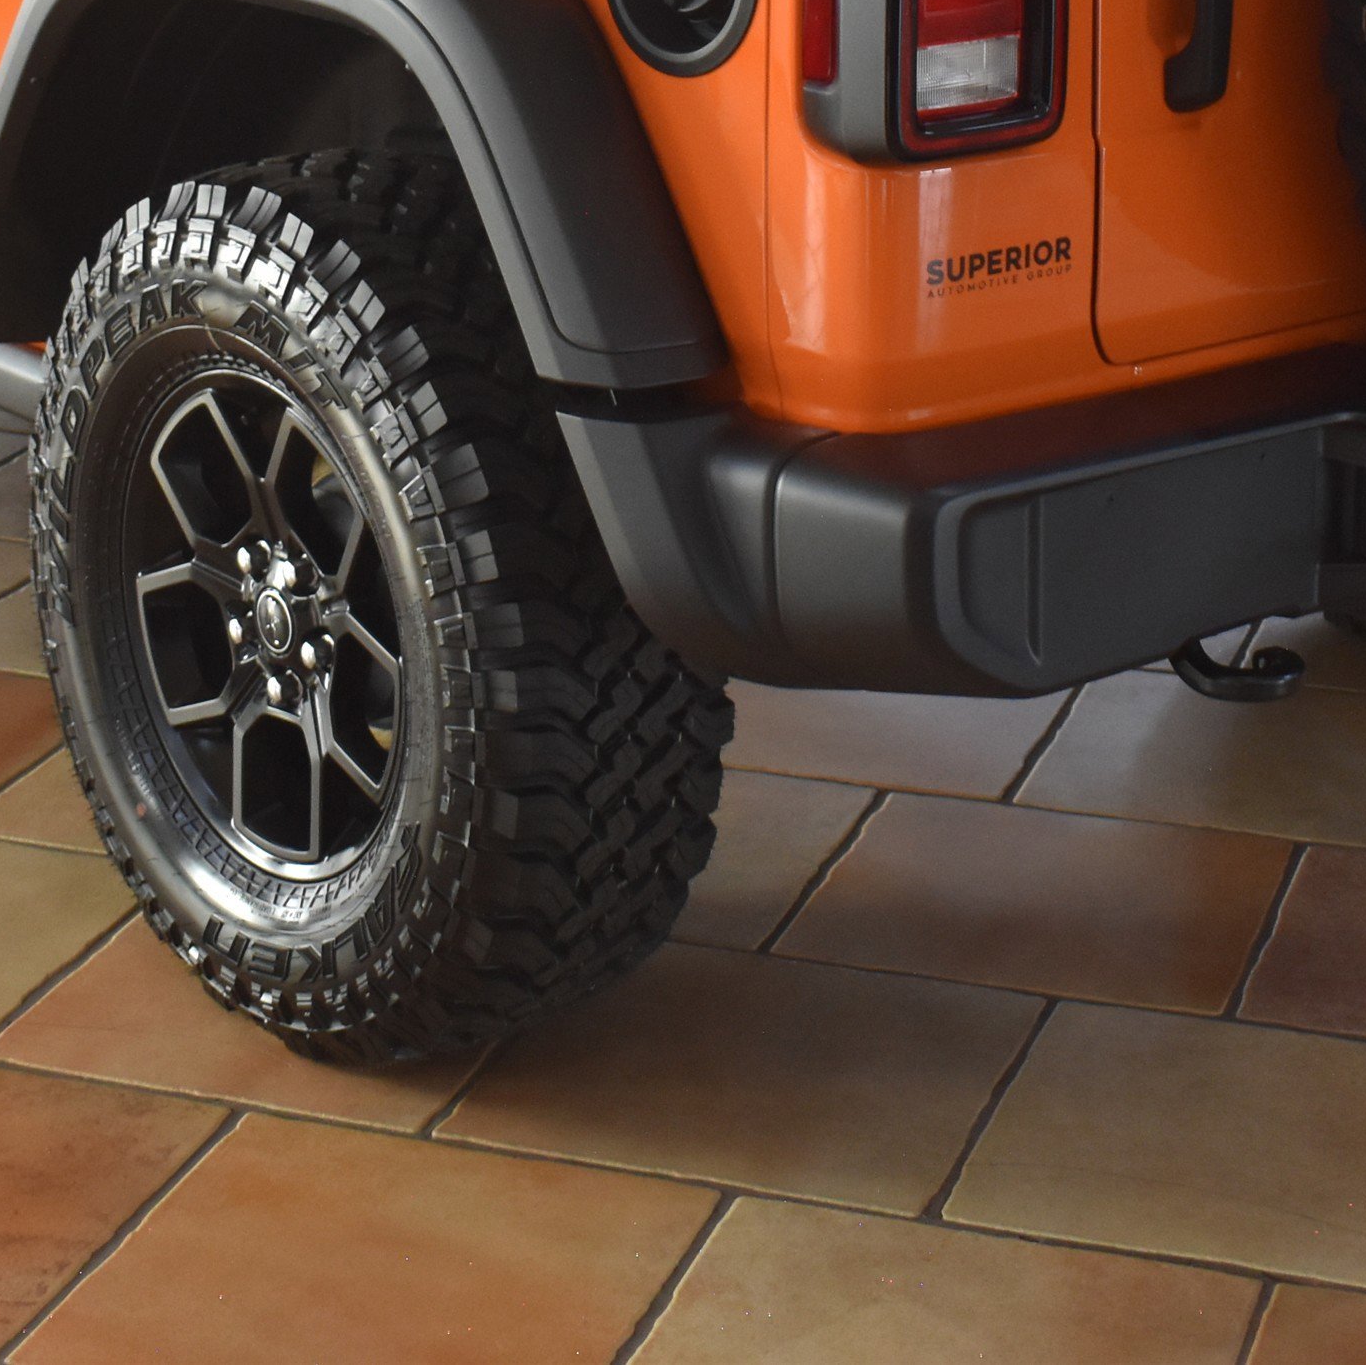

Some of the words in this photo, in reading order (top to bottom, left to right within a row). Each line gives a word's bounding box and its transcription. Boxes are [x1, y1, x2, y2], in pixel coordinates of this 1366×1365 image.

[926, 236, 1072, 286] SUPERIOR
[926, 275, 1019, 299] AUTOMOTIVE
[1026, 264, 1072, 281] GROUP
[48, 278, 208, 628] WILDPEAK
